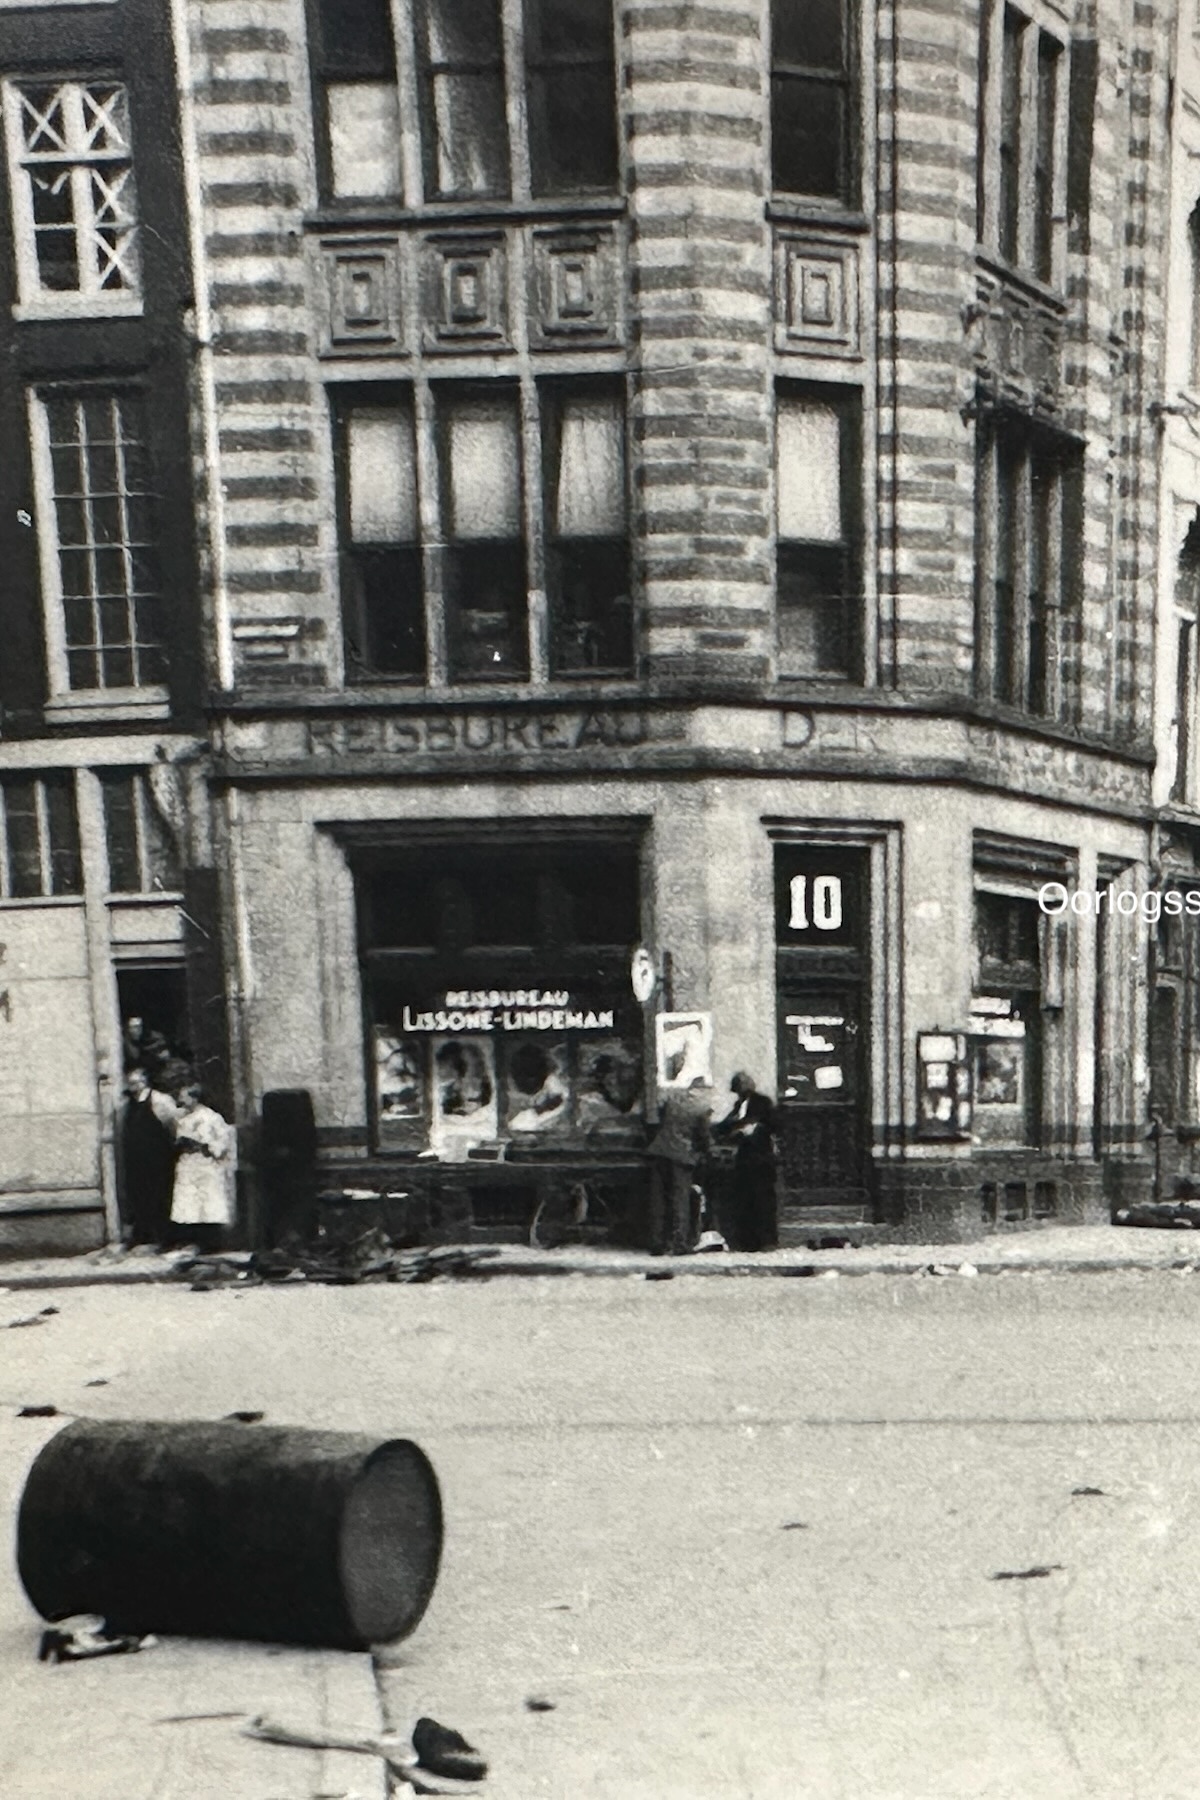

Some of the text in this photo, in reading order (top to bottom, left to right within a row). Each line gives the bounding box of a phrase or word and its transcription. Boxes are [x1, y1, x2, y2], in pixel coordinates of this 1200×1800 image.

[306, 708, 650, 752] REISBUREAU
[788, 874, 843, 930] 10
[445, 989, 570, 1008] REISBUREAU
[402, 1005, 615, 1032] LISSONE-LINDEMAN
